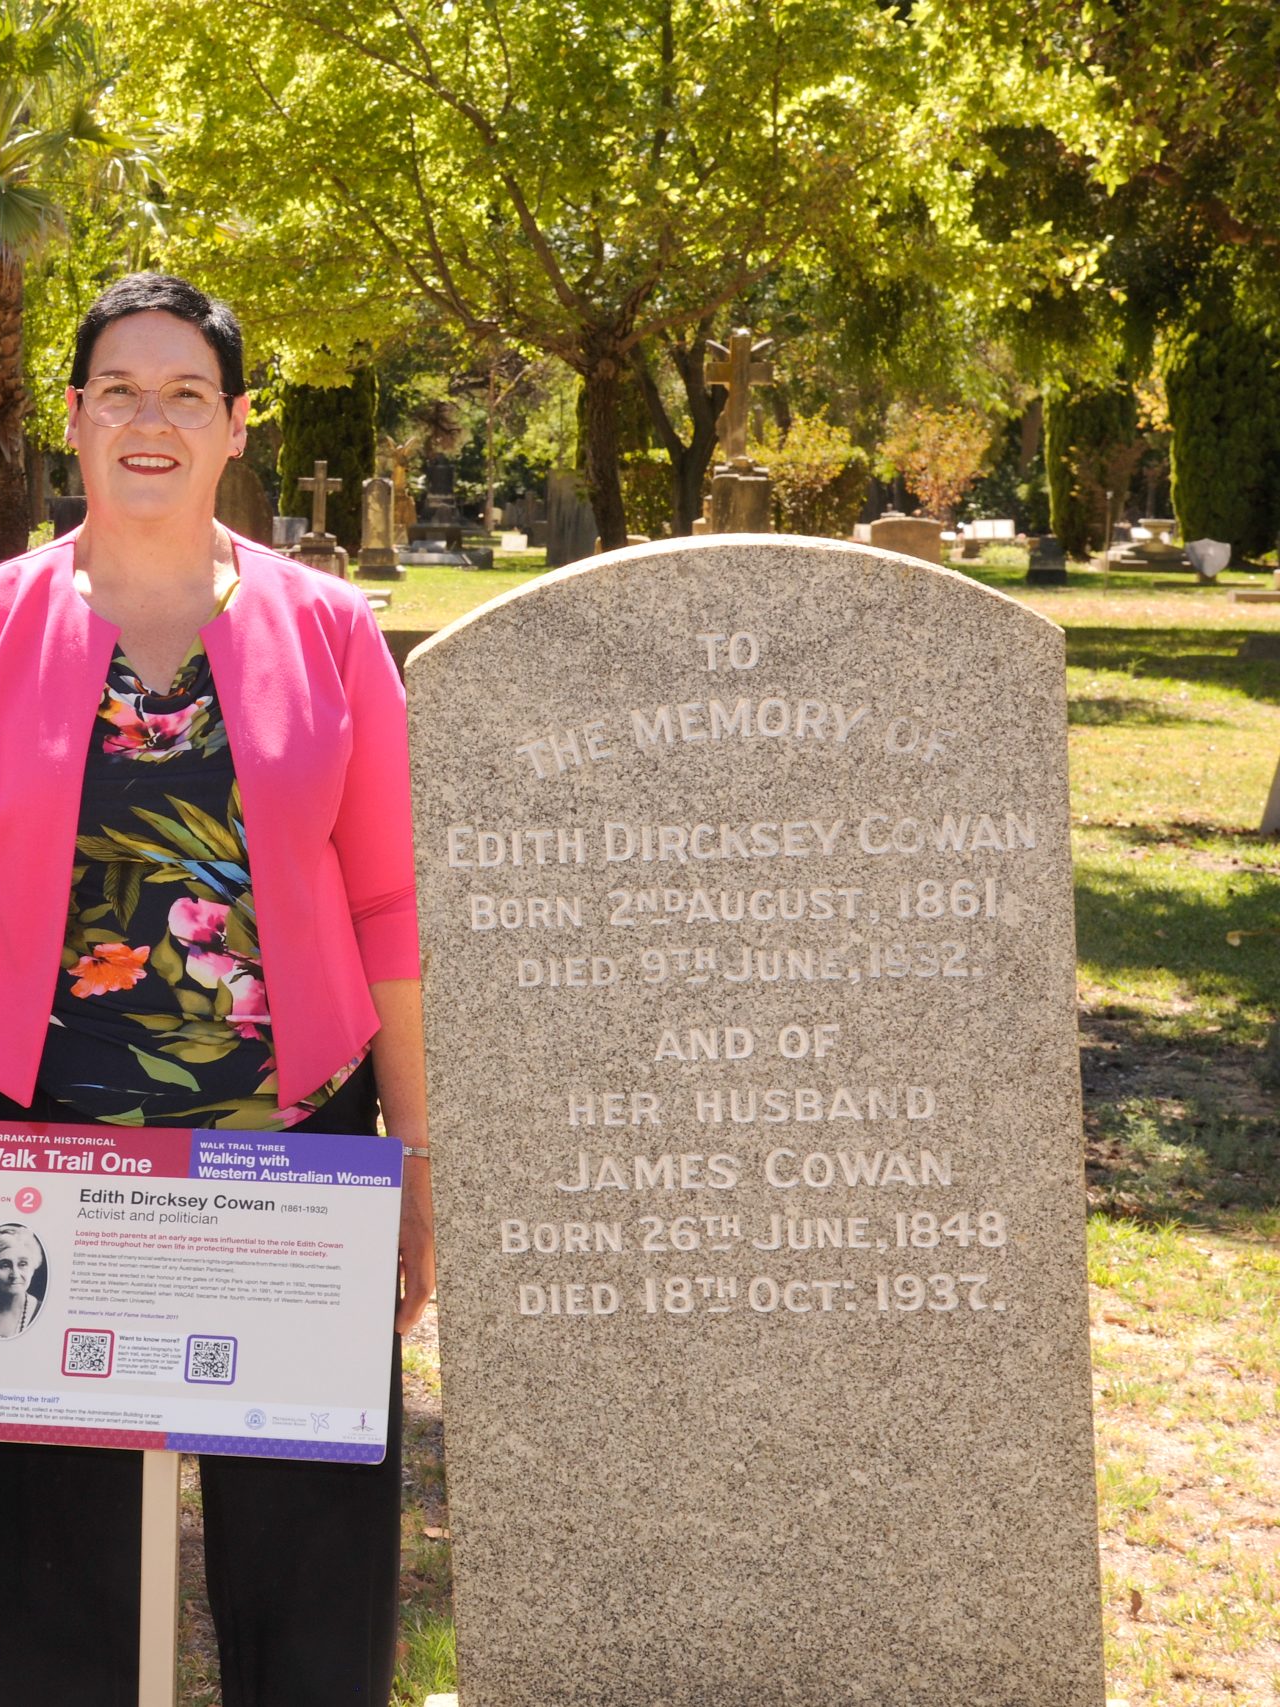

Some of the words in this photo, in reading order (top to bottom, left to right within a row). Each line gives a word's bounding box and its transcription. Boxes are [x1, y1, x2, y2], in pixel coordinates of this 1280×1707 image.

[696, 631, 761, 671] TO
[517, 720, 613, 780] THE
[630, 698, 869, 750] MEMORY
[884, 714, 958, 763] OF
[447, 825, 585, 868] EDITH
[604, 819, 845, 863] DIRCKSEY
[858, 811, 1036, 854] COWAN
[470, 893, 583, 931] BORN
[518, 956, 619, 988] DIED
[654, 1025, 755, 1061] AND
[778, 1023, 840, 1058] OF
[567, 1092, 661, 1126] HER
[696, 1086, 937, 1123] HUSBAND
[54, 1136, 116, 1145] HISTORICAL
[43, 1150, 93, 1170] Trail
[101, 1152, 151, 1173] One
[198, 1151, 255, 1167] Walking
[258, 1153, 289, 1166] with
[556, 1151, 740, 1192] JAMES
[765, 1148, 952, 1188] COWAN
[198, 1166, 256, 1179] Western
[260, 1169, 332, 1183] Australian
[337, 1172, 390, 1185] Women
[22, 1191, 34, 1207] 2
[80, 1188, 124, 1203] Edith
[131, 1190, 207, 1210] Dircksey
[214, 1194, 274, 1210] Cowan
[280, 1204, 327, 1214] (1861-1932)
[77, 1207, 125, 1219] Activist
[129, 1209, 154, 1220] and
[159, 1211, 217, 1225] politician
[501, 1219, 622, 1253] BORN
[895, 1210, 1009, 1248] 1848
[100, 1240, 140, 1248] throughout
[195, 1245, 234, 1253] protecting
[119, 1232, 147, 1240] parents
[168, 1234, 187, 1242] early
[519, 1282, 620, 1315] DIED
[876, 1272, 1007, 1312] 1937.
